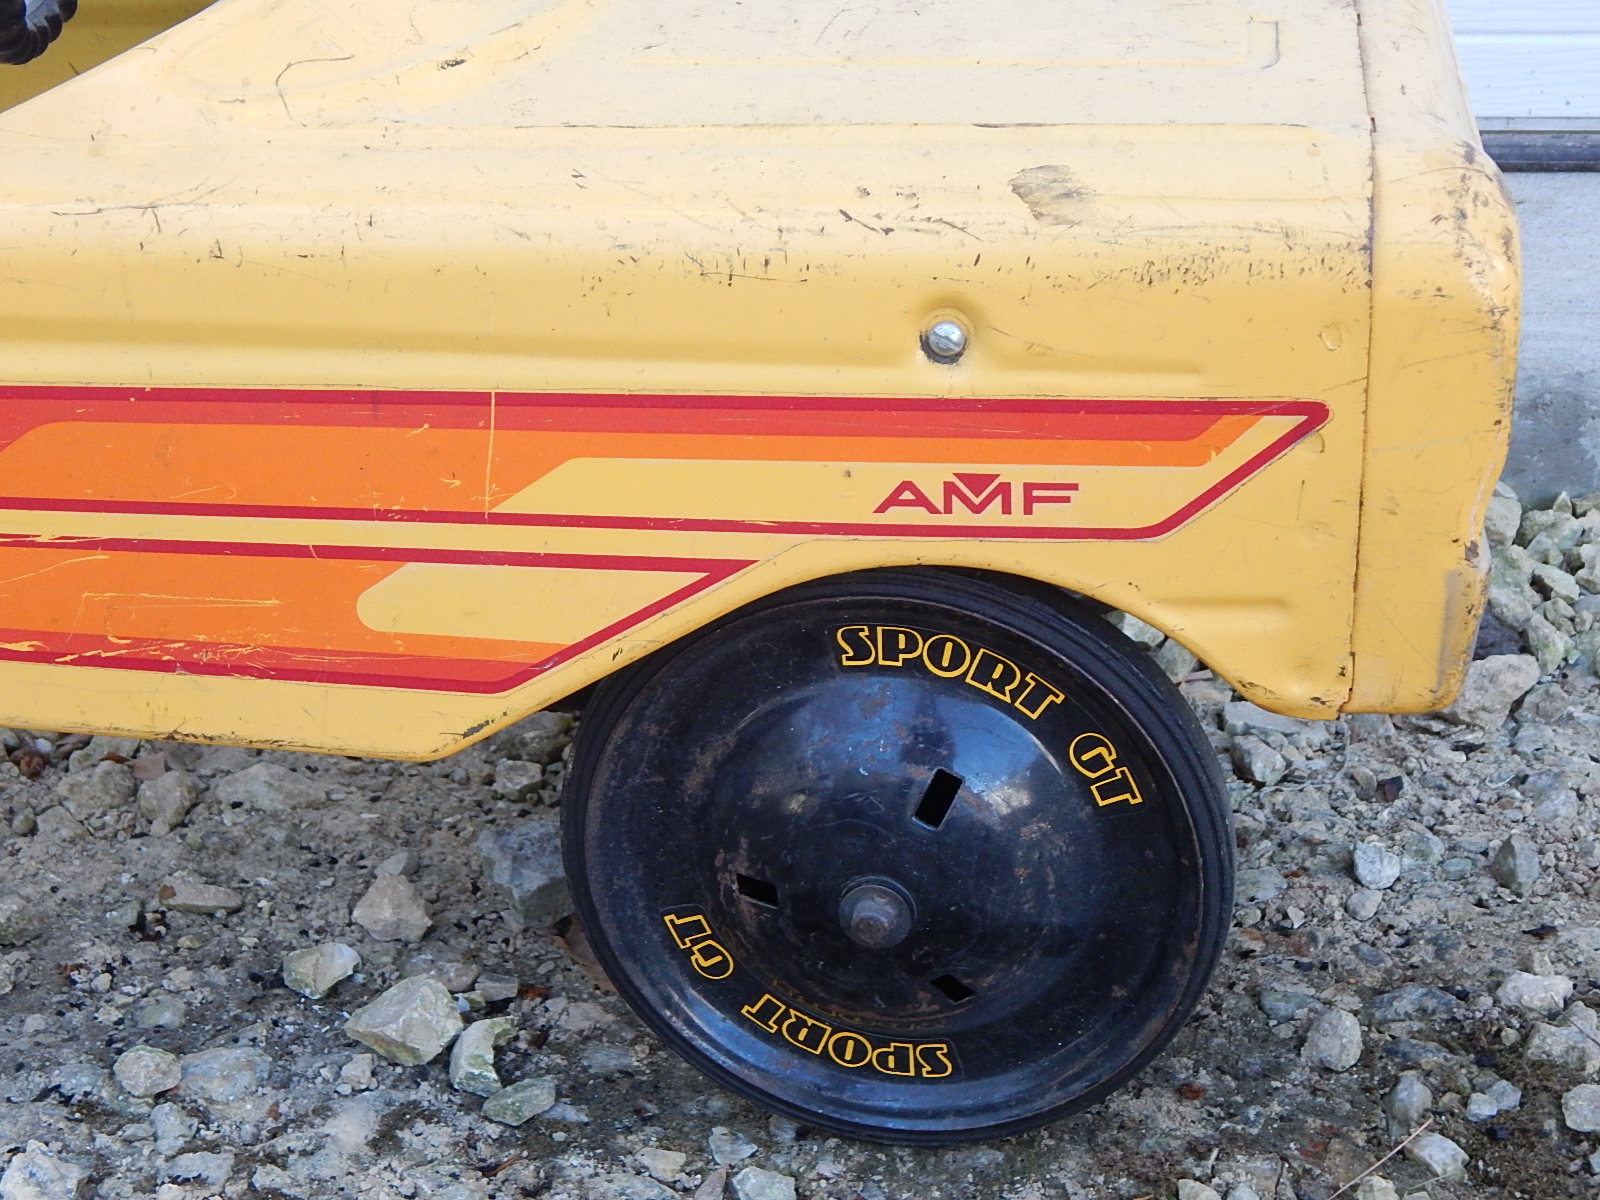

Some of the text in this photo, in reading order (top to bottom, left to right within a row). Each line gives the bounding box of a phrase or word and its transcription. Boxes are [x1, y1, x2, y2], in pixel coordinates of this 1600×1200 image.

[872, 472, 1079, 516] AMF
[836, 625, 1143, 807] SPORT GT
[663, 913, 953, 1078] SPORT GT
